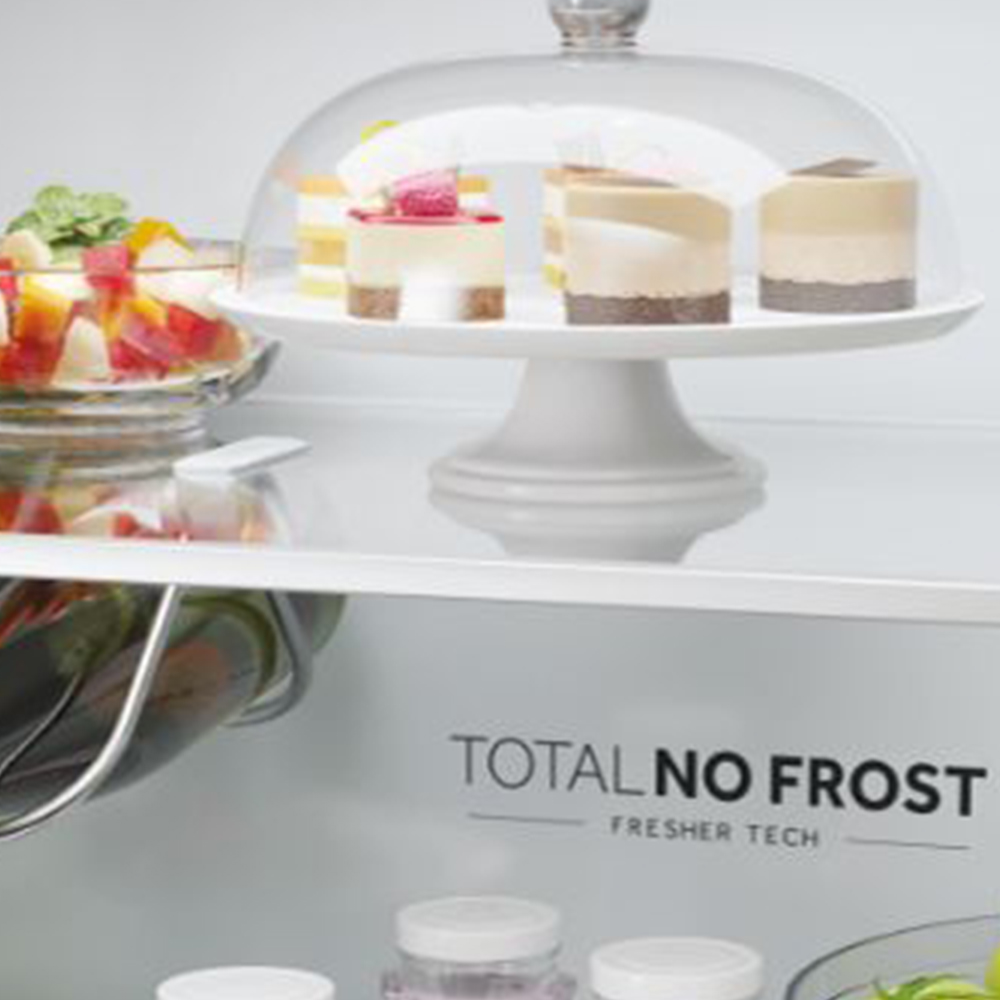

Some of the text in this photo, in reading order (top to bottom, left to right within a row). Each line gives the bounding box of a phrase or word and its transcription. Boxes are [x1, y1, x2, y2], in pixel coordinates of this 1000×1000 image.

[449, 732, 989, 818] TOTAL NO FROST
[609, 815, 820, 849] FRESHER TECH
